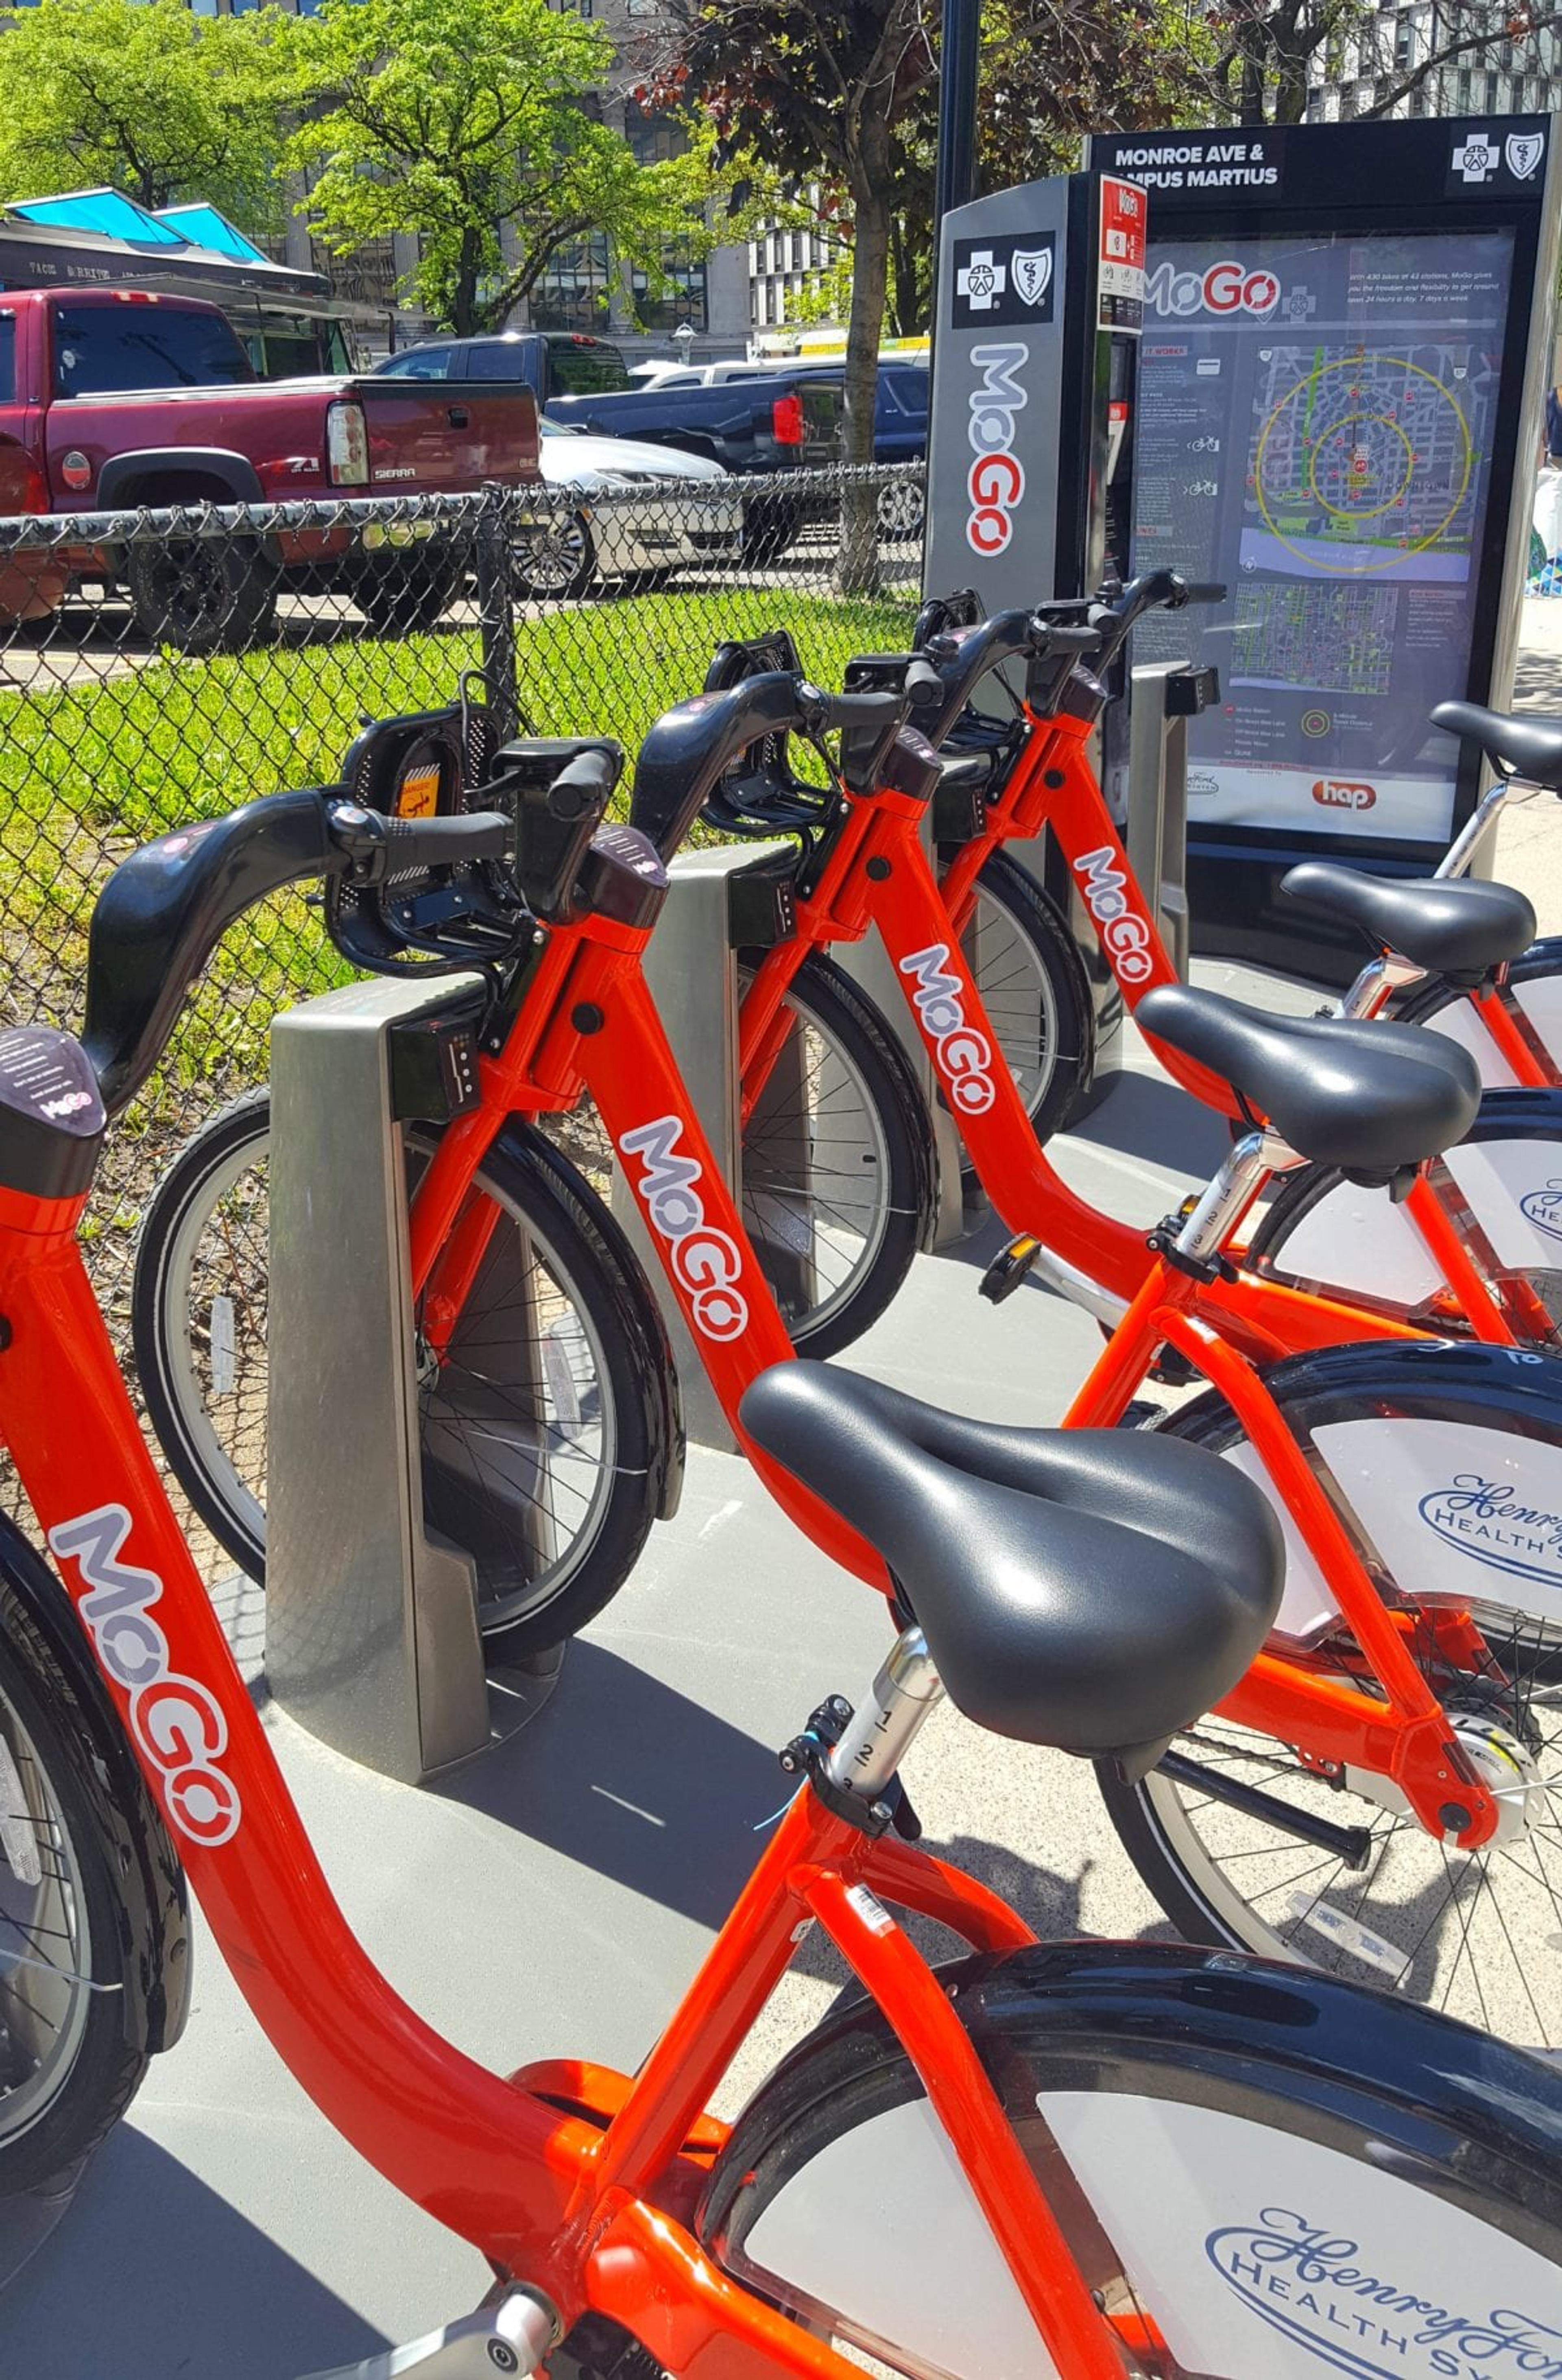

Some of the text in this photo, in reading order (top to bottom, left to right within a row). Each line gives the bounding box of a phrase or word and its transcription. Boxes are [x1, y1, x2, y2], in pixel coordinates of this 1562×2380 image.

[1115, 144, 1264, 166] MONROE AVE &
[1187, 168, 1278, 187] MARTIUS
[1143, 261, 1281, 316] MoGo
[375, 468, 416, 479] SIERRA
[966, 343, 1029, 557] MoGo
[1322, 780, 1369, 810] hap
[1073, 846, 1153, 983] MoGo
[899, 943, 995, 1115] MoGo
[619, 1115, 748, 1342] MoGo
[1434, 1508, 1544, 1553] HEALTH
[48, 1502, 242, 1847] MoGo
[1230, 2251, 1408, 2354] HEALTH
[1250, 2207, 1469, 2345] Henry
